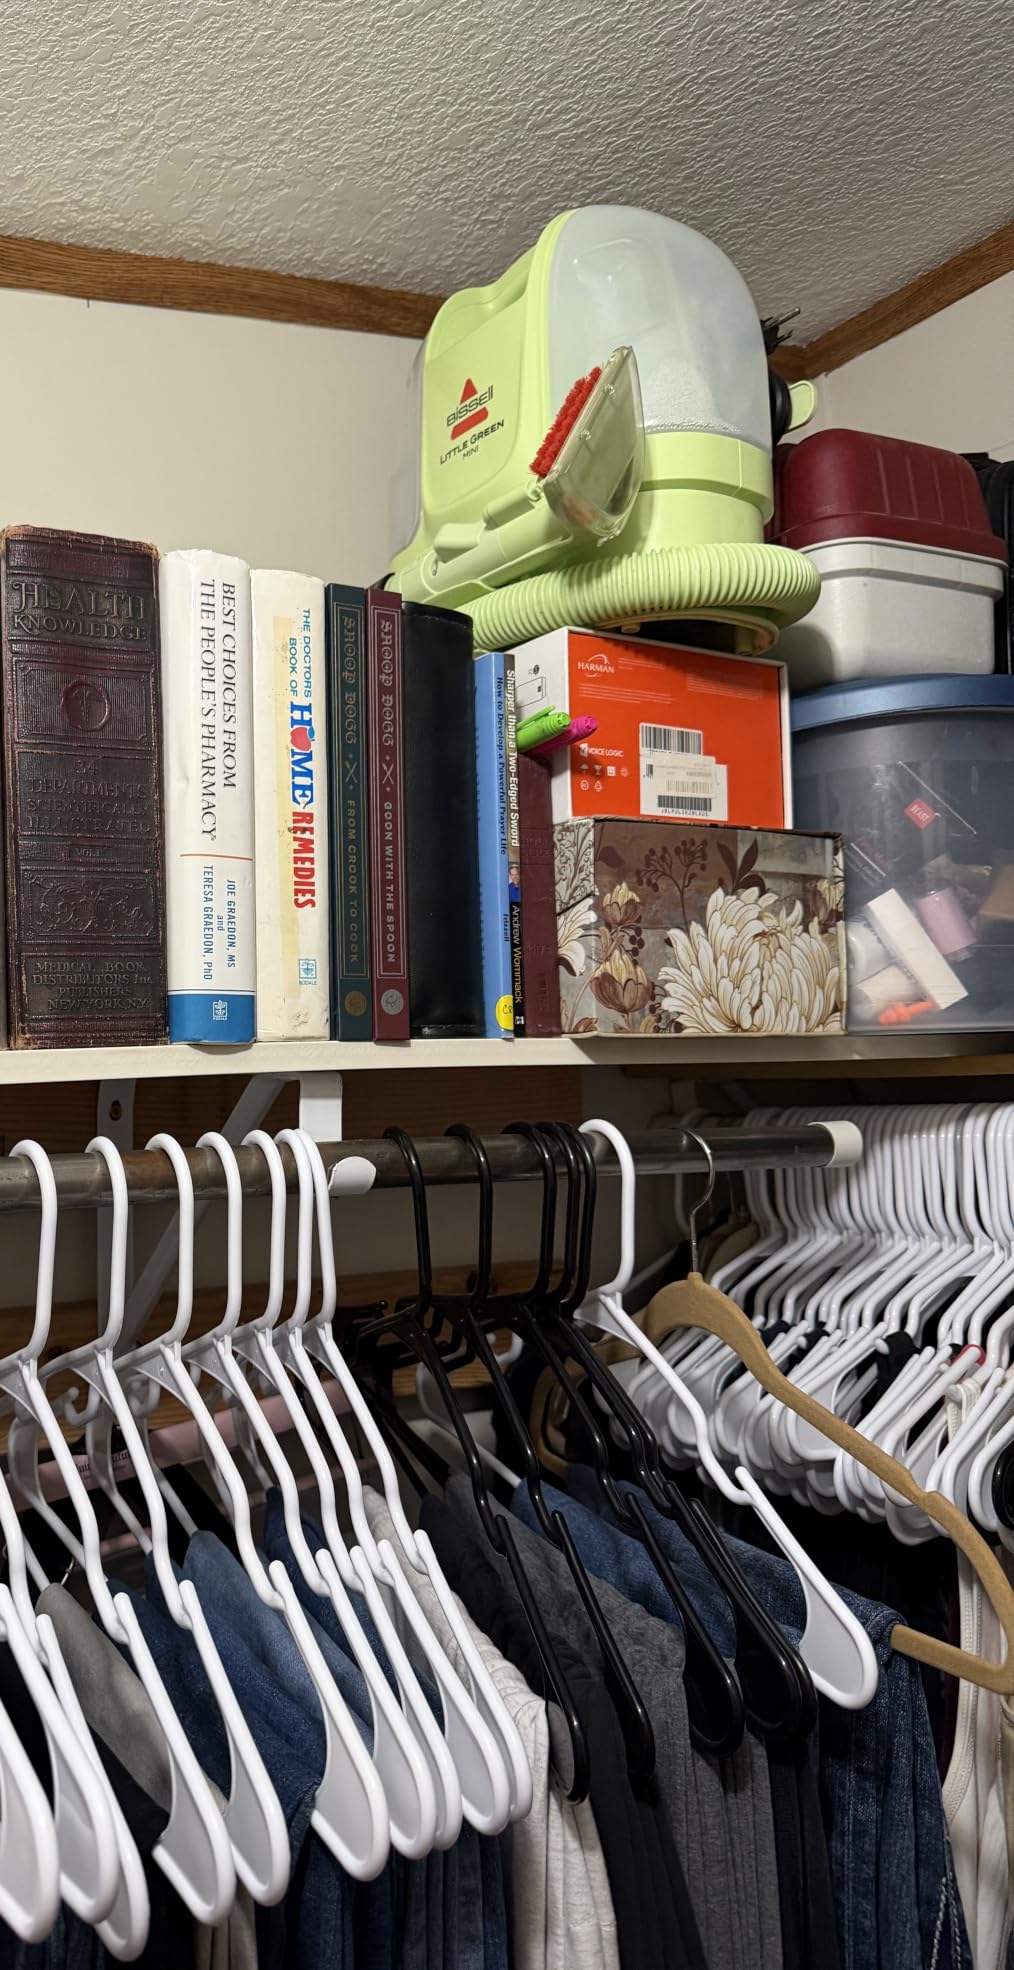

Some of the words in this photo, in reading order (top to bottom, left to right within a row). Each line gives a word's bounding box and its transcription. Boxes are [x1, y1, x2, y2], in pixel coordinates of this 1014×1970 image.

[440, 440, 469, 464] LITTLE
[470, 419, 504, 444] GREEN
[462, 445, 479, 460] MINI
[12, 581, 145, 620] HEALTH
[200, 579, 215, 620] THE
[222, 582, 236, 631] BEST
[14, 614, 147, 640] KNOWLEDGE
[303, 608, 311, 632] THE
[289, 638, 297, 674] BOOK
[303, 636, 312, 698] DOCTORS
[342, 616, 356, 684] SNOOP
[379, 620, 393, 686] SNOOP
[578, 661, 614, 674] HARMAN
[201, 626, 217, 717] PEOPLE'S
[222, 634, 237, 723] CHOICES
[289, 680, 298, 697] OF
[496, 677, 504, 698] How
[506, 669, 516, 712] Sharper
[344, 692, 357, 744] DOGG
[382, 693, 394, 746] DOGG
[497, 701, 503, 710] to
[508, 715, 516, 738] than
[223, 730, 237, 788] FROM
[508, 752, 519, 810] Two-Edged
[348, 800, 356, 840] FROM
[384, 801, 393, 840] GOON
[498, 807, 506, 834] Prayer
[510, 813, 520, 847] Sword
[292, 811, 317, 909] REMEDIES
[385, 846, 395, 880] WITH
[500, 838, 508, 855] Life
[203, 865, 214, 902] TERESA
[227, 880, 236, 896] JOE
[348, 845, 357, 894] CROOK
[349, 901, 358, 917] TO
[386, 884, 395, 910] THE
[203, 907, 214, 957] GRAEDON,
[216, 914, 225, 931] and
[227, 901, 236, 951] GRAEDON,
[386, 915, 396, 963] SPOON
[512, 905, 521, 945] Andrew
[227, 954, 236, 968] MS
[350, 923, 359, 962] COOK
[33, 974, 130, 985] DISTRIBUTORS
[36, 961, 96, 972] MEDICAL
[105, 961, 148, 972] BOOK
[203, 962, 213, 980] PhD
[513, 947, 524, 1003] Wommack
[48, 999, 80, 1010] NEW
[59, 986, 131, 997] PUBLISHERS
